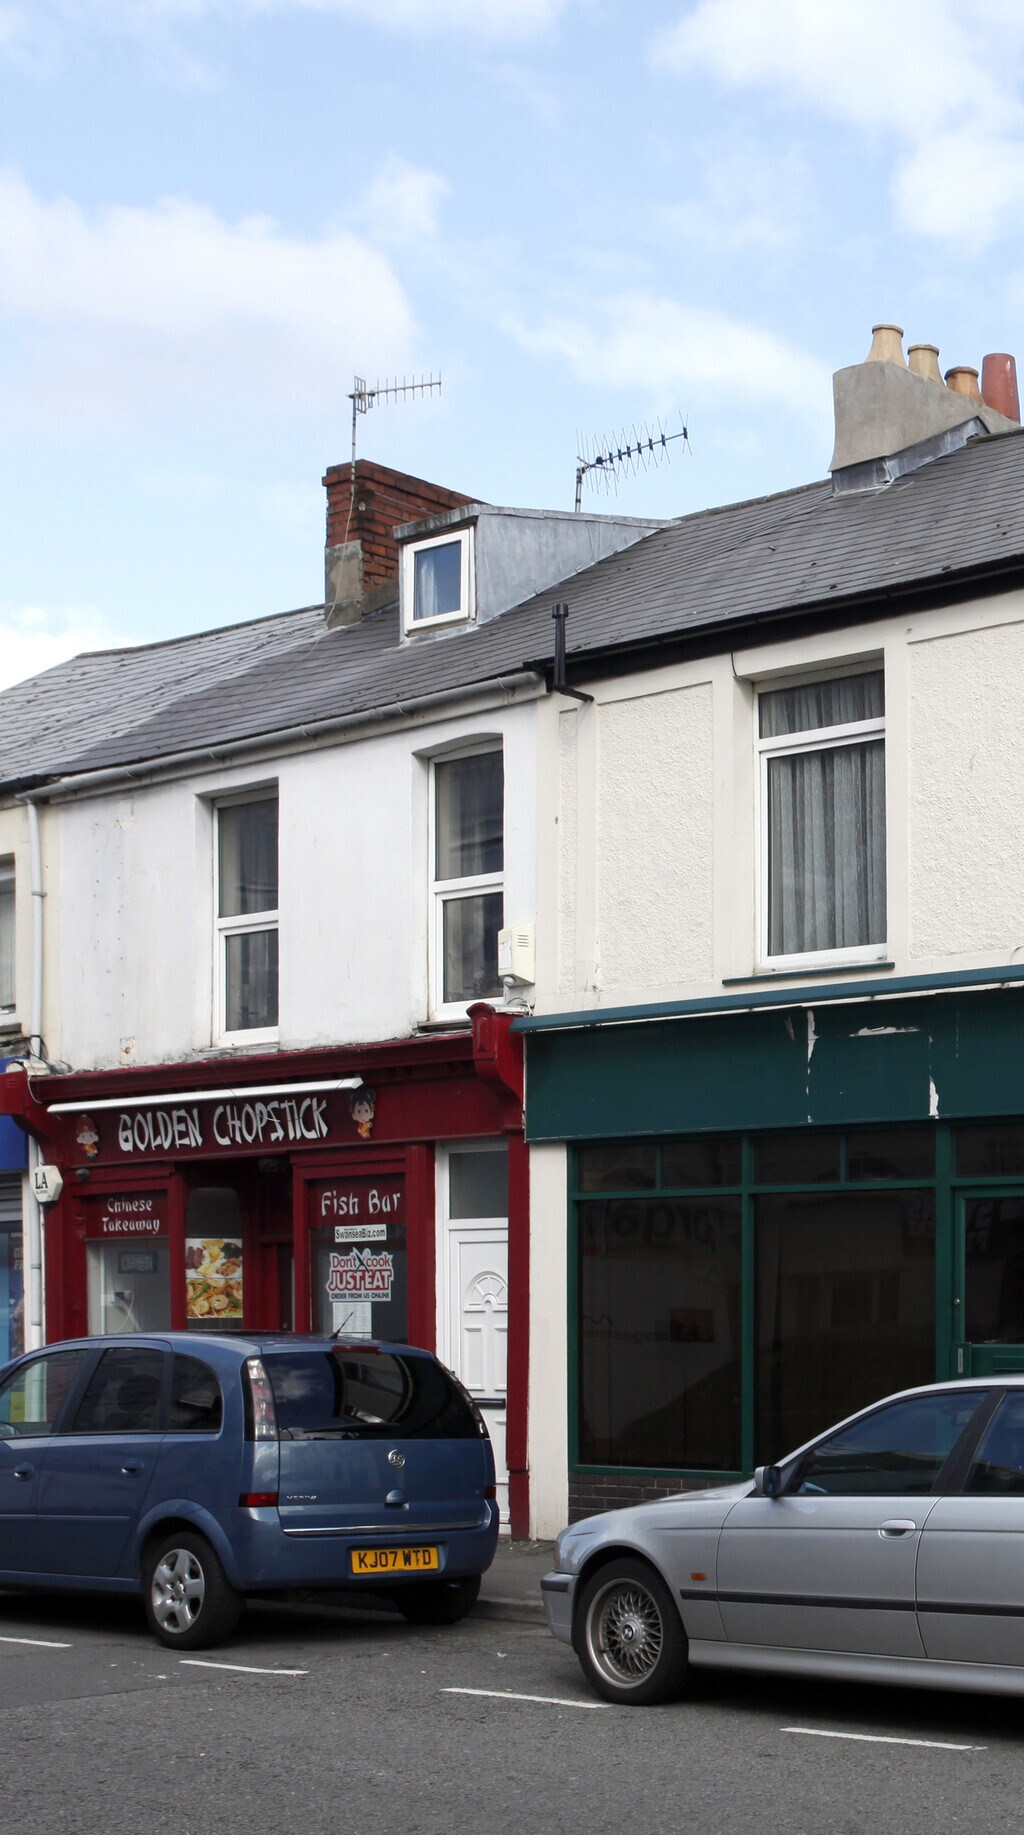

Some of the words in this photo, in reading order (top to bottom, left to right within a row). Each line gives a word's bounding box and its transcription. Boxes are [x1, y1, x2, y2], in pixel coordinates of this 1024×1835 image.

[118, 1108, 203, 1152] GOLDEN
[213, 1097, 329, 1146] CHOPSTICK
[107, 1196, 153, 1213] Chinese
[321, 1190, 359, 1216] Fish
[368, 1189, 401, 1214] Bar
[101, 1216, 160, 1235] Takeaway
[332, 1254, 358, 1269] Don't
[365, 1254, 391, 1268] cook
[329, 1270, 363, 1290] JUST
[364, 1270, 392, 1290] EAT
[330, 1292, 347, 1300] ORDER
[371, 1291, 390, 1299] ONLINE
[358, 1550, 398, 1569] KJ07
[402, 1549, 432, 1567] WTD
